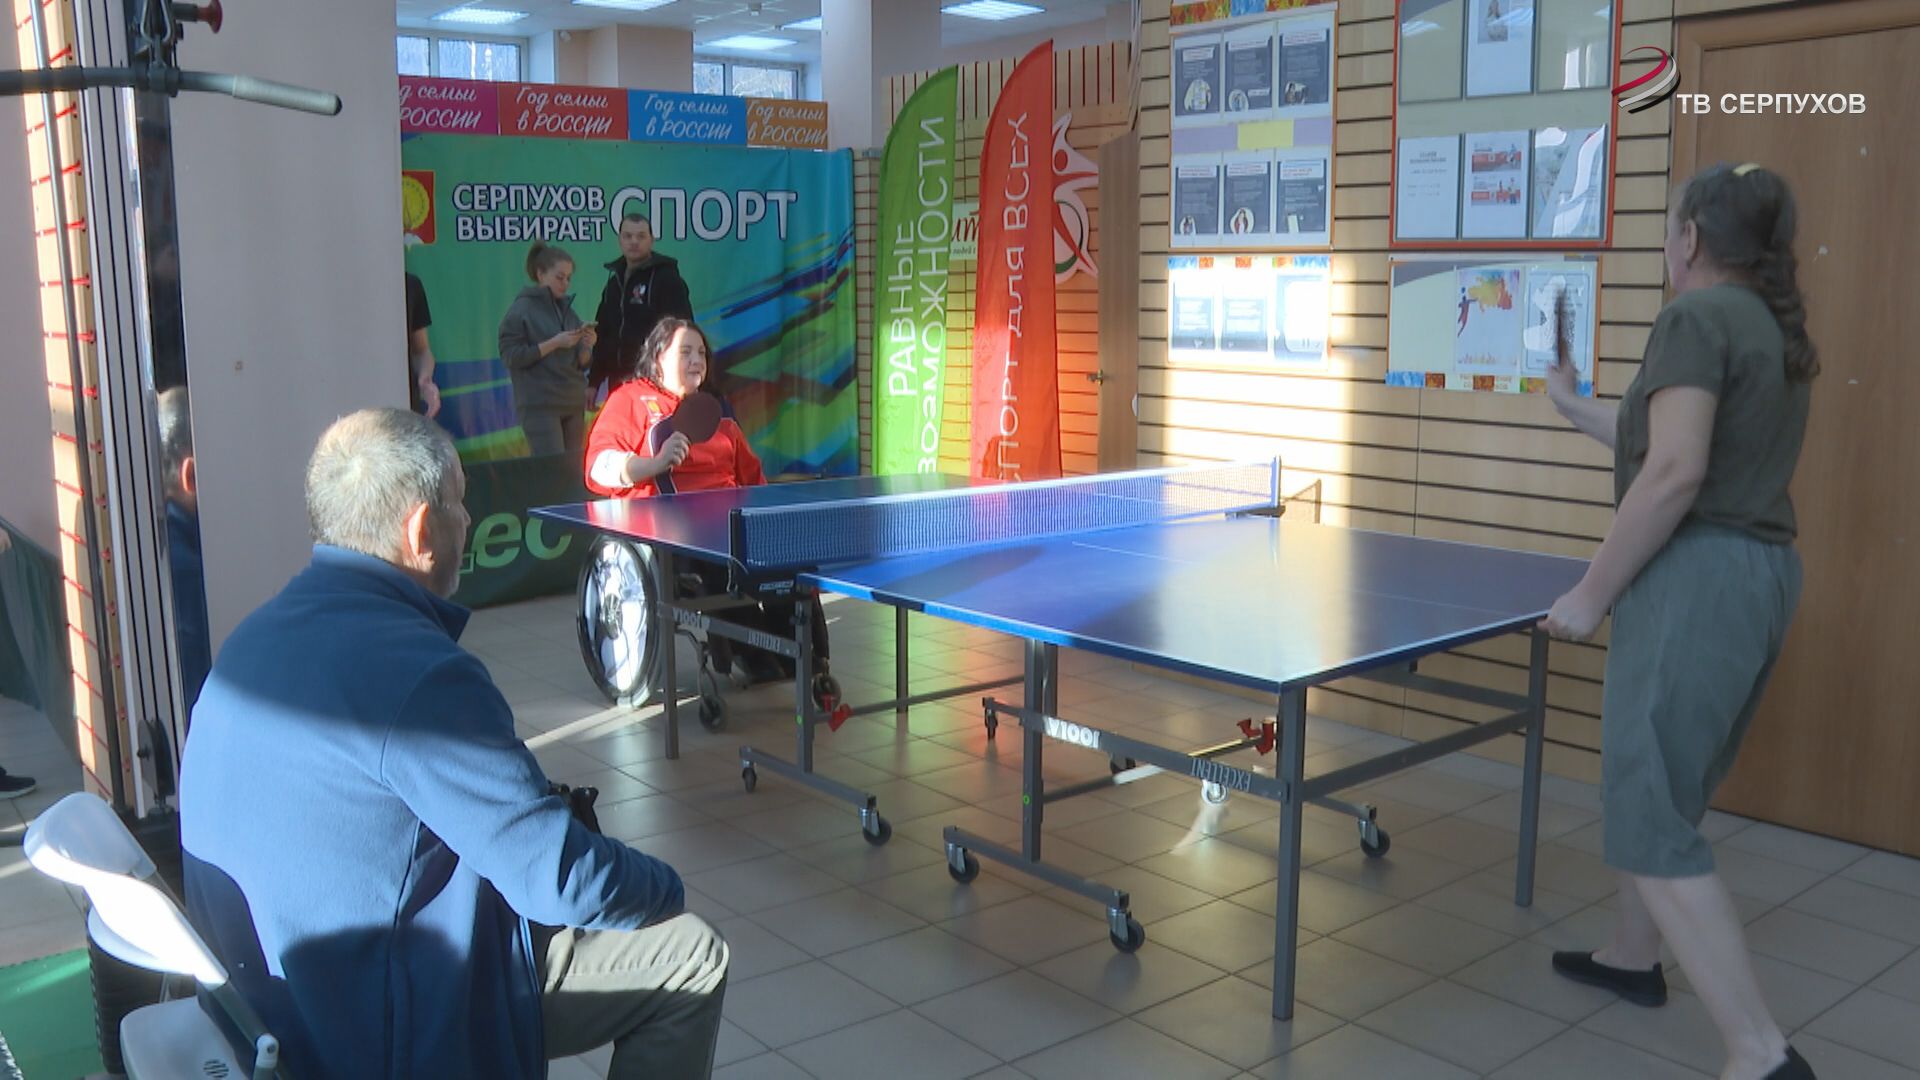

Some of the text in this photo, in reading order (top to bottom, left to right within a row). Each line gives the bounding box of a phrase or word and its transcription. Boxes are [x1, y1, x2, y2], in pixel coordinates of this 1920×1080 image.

[516, 86, 609, 113] Год семьи
[644, 94, 729, 119] Год семьи
[747, 101, 825, 123] Год семьи
[533, 112, 613, 136] РОССИИ
[661, 119, 732, 140] РОССИИ
[761, 124, 828, 144] РОССИИ
[1003, 112, 1030, 231] ВСЕХ
[453, 183, 606, 212] СЕРПУХОВ
[457, 215, 607, 241] ВЫБИРАЕТ
[609, 187, 798, 242] СПОРТ
[887, 220, 918, 397] РАВНЫЕ
[1047, 717, 1100, 749] JOOLA
[1190, 758, 1251, 792] EXCELLENT
